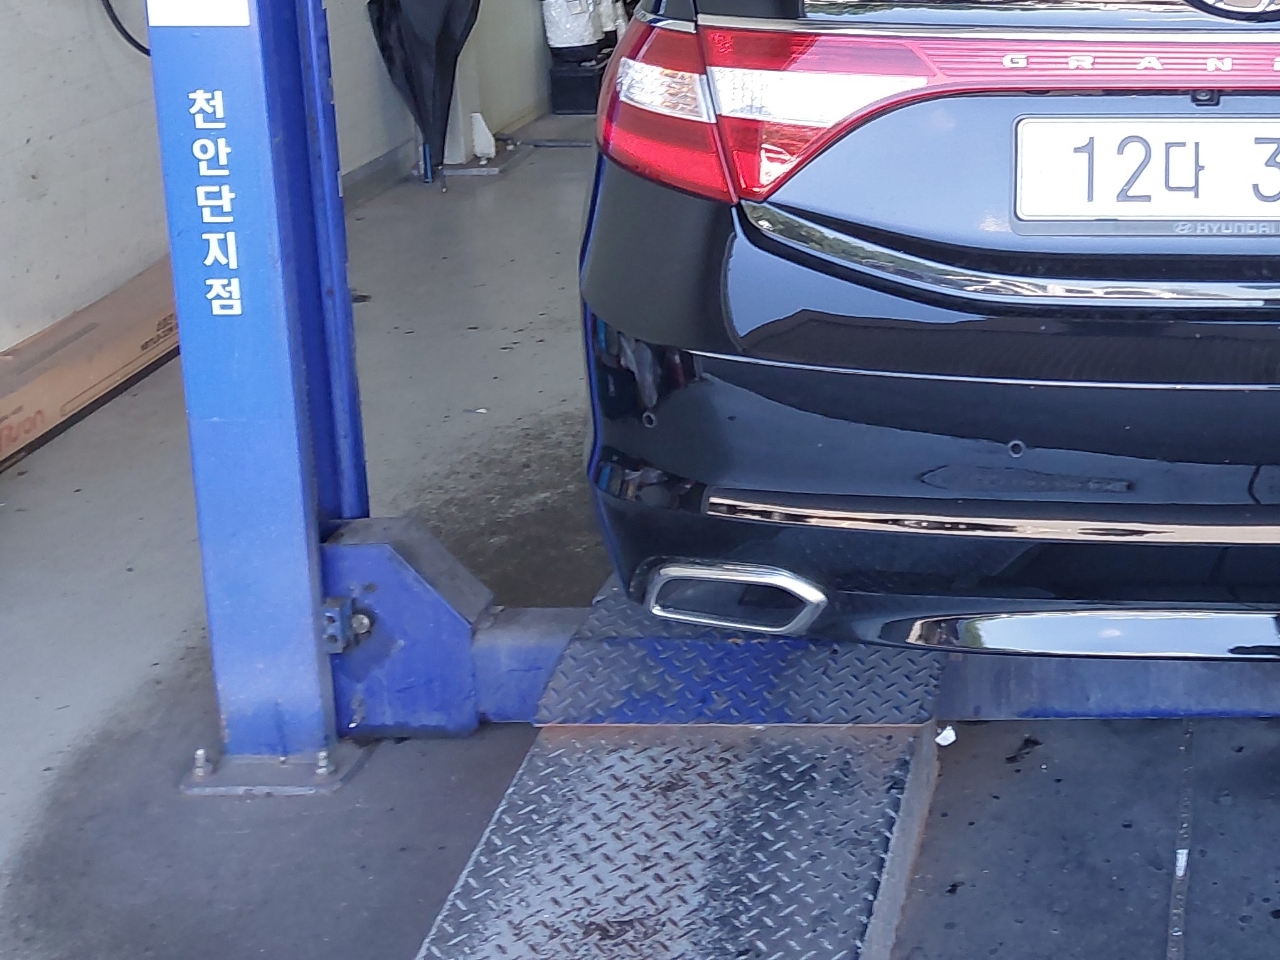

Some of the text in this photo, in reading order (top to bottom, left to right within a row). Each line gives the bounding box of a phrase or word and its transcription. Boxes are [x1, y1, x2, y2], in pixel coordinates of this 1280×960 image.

[187, 88, 244, 317] 천안단지점
[1072, 134, 1206, 203] 12다
[1196, 222, 1275, 234] HYUNDAI
